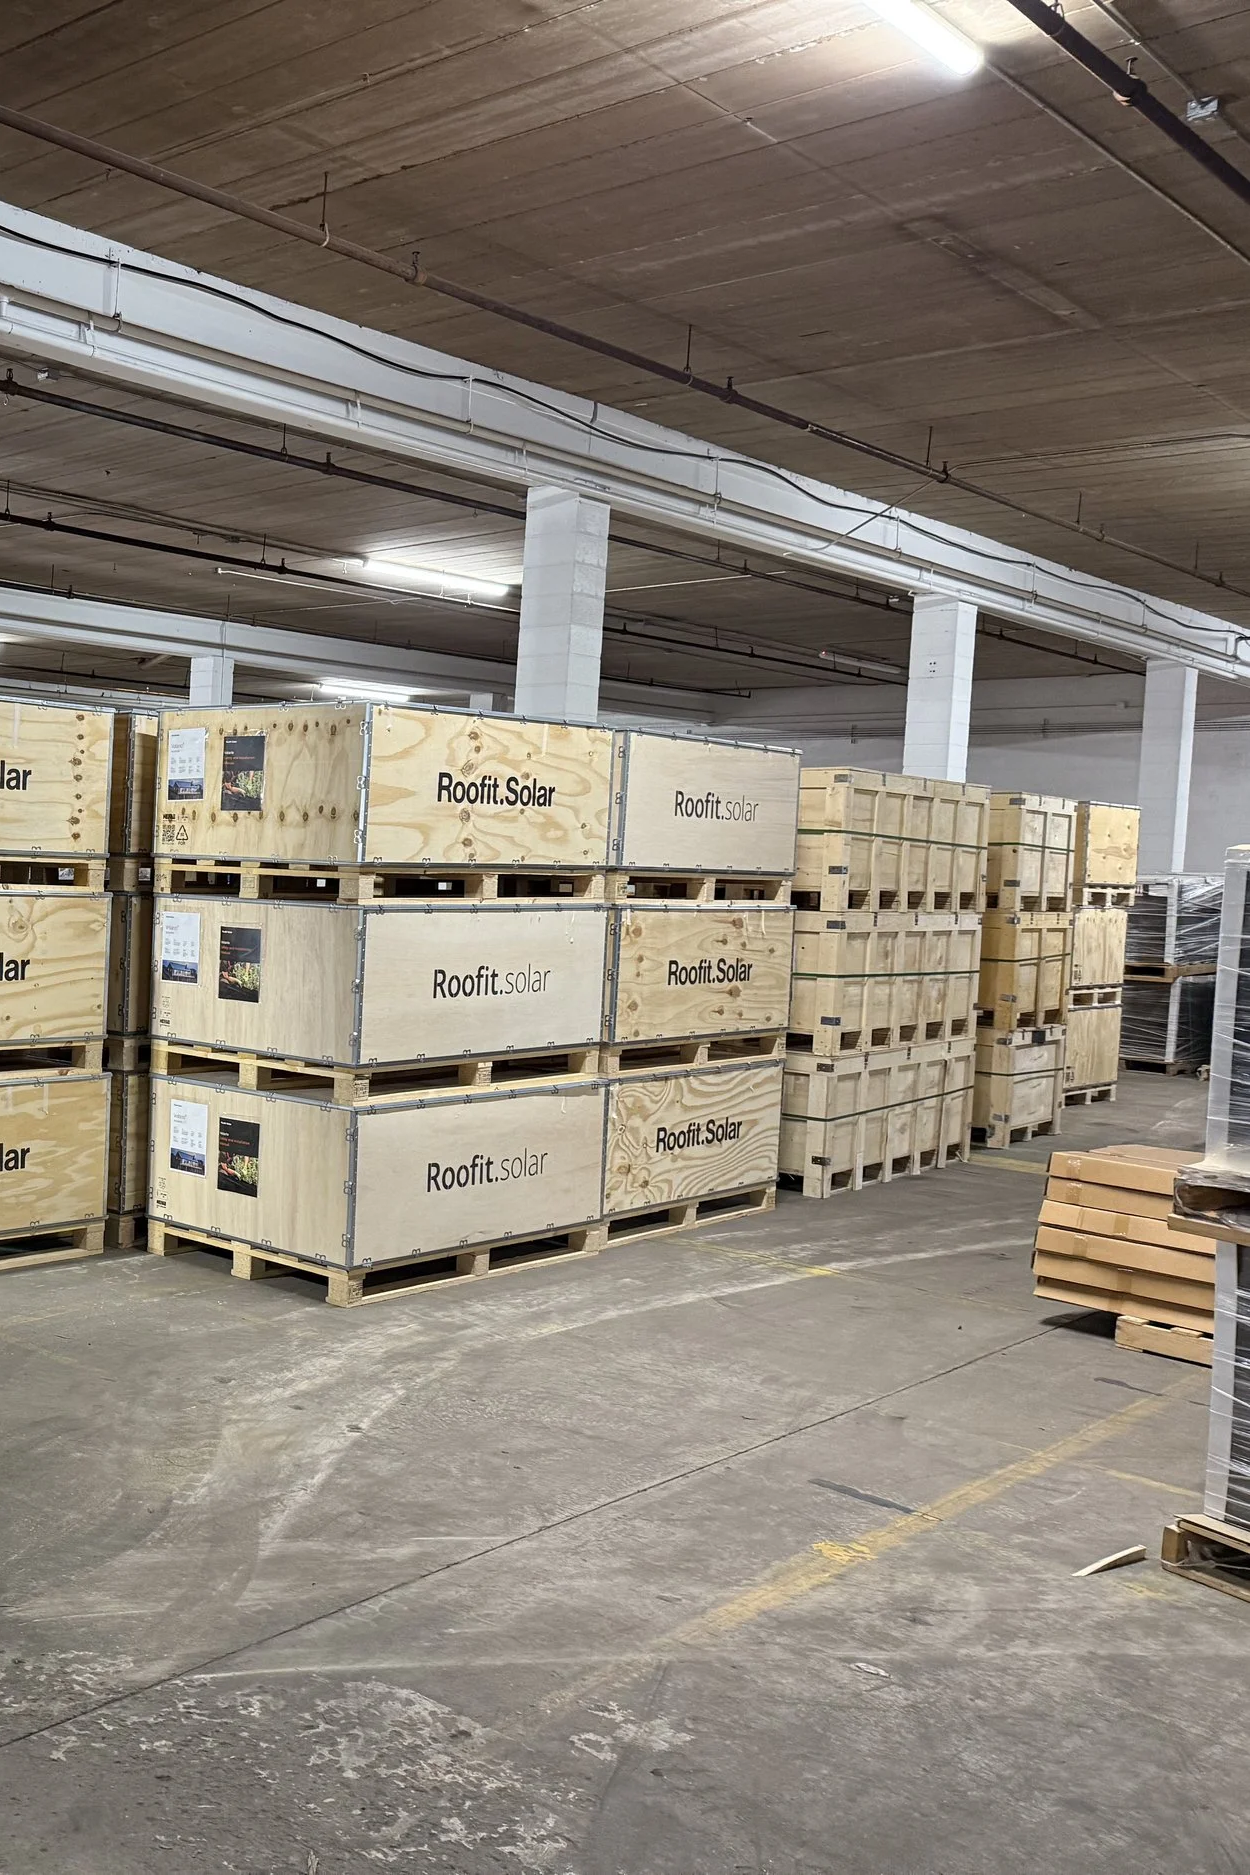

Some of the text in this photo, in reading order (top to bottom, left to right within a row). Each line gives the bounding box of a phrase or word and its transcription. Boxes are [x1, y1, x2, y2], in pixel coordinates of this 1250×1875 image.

[438, 772, 555, 806] Roofit.Solar
[675, 790, 758, 822] Roofit.solar
[433, 963, 550, 998] Roofit.solar
[668, 958, 752, 985] Roofit.Solar
[656, 1117, 742, 1152] Roofit.Solar
[428, 1149, 547, 1193] Roofit.solar
